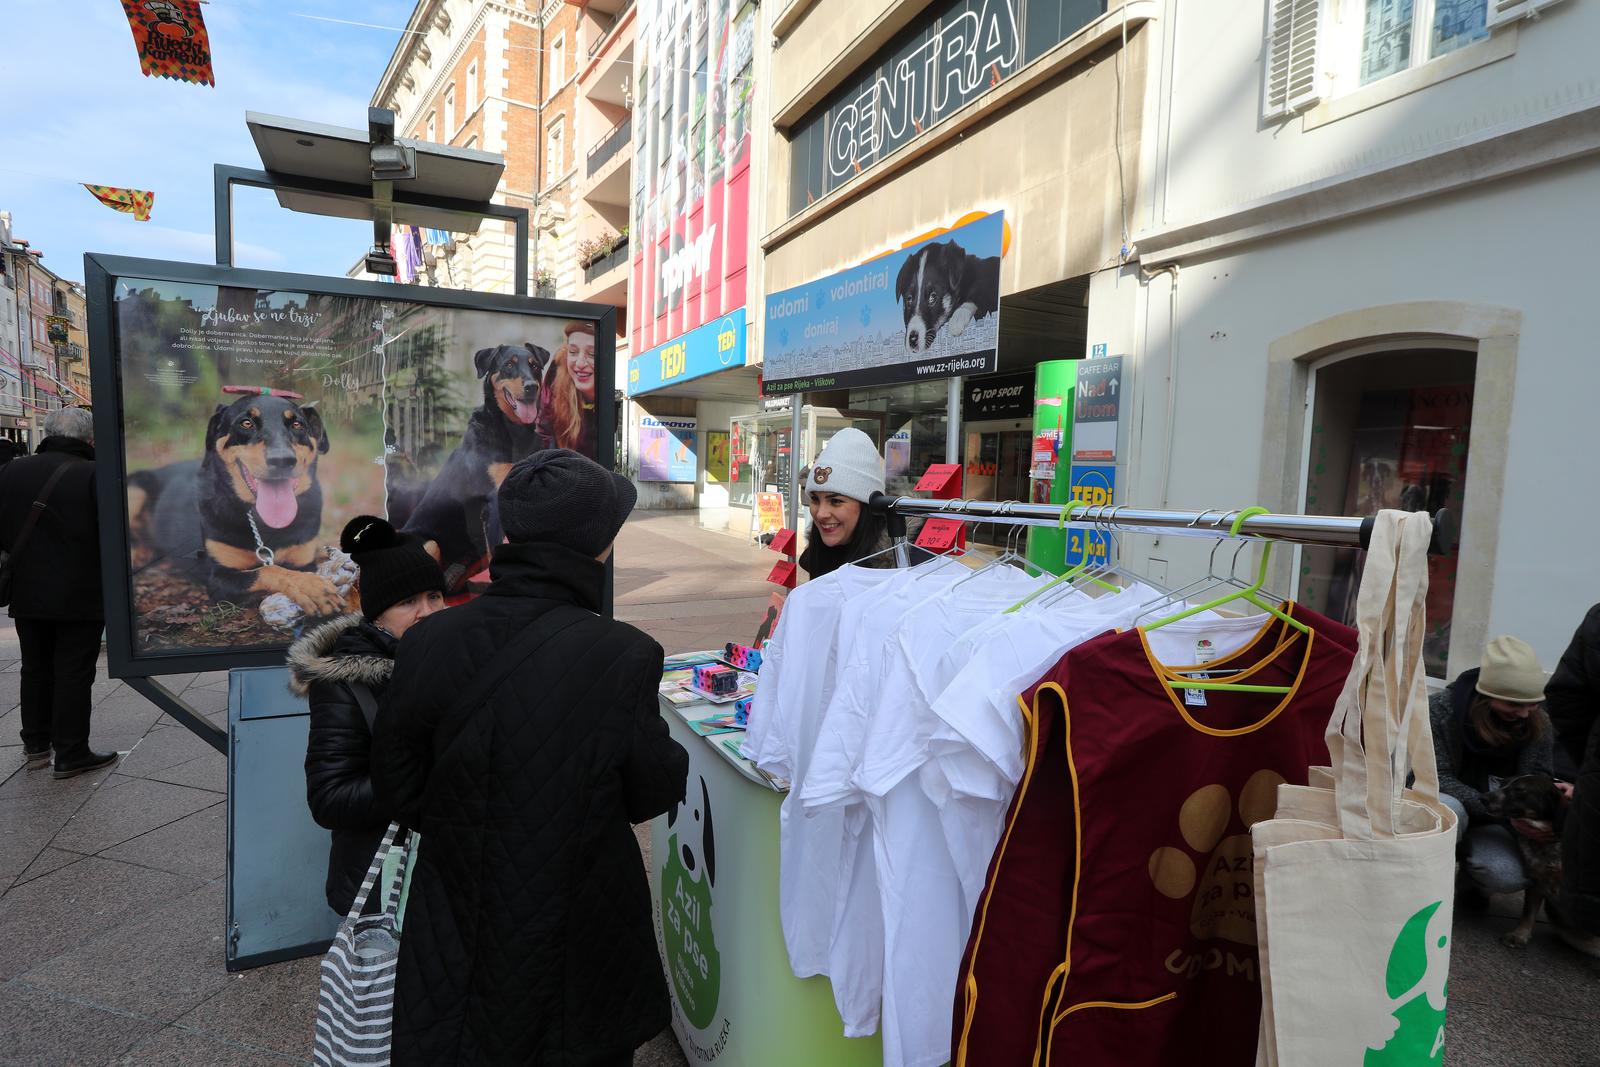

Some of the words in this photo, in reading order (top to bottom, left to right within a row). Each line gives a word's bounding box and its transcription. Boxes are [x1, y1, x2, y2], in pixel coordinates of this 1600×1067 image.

[829, 0, 1019, 176] CENTRA
[661, 223, 716, 298] TOMMY
[831, 266, 889, 302] volontiraj
[254, 311, 267, 322] se
[271, 311, 287, 322] ne
[769, 292, 809, 320] udomi
[180, 327, 197, 335] Dolly
[804, 316, 839, 339] doniraj
[717, 328, 736, 353] TEDi
[1094, 345, 1104, 355] 12
[660, 341, 686, 382] TEDi
[916, 356, 986, 375] www.zz-rijeka.org
[1079, 364, 1101, 376] CAFFE
[1102, 362, 1119, 374] BAR
[320, 373, 359, 393] Dolly
[766, 383, 776, 391] Azil
[777, 383, 784, 391] za
[784, 382, 793, 391] pse
[794, 380, 810, 391] Rijeka
[815, 377, 836, 388] Viškovo
[982, 388, 998, 399] TOP
[997, 385, 1024, 398] SPORT
[1072, 485, 1113, 507] TEDi
[1071, 536, 1082, 553] 2.
[675, 875, 701, 932] Azil
[667, 897, 681, 935] za
[684, 926, 709, 981] pse
[713, 1017, 731, 1058] RIJEKA
